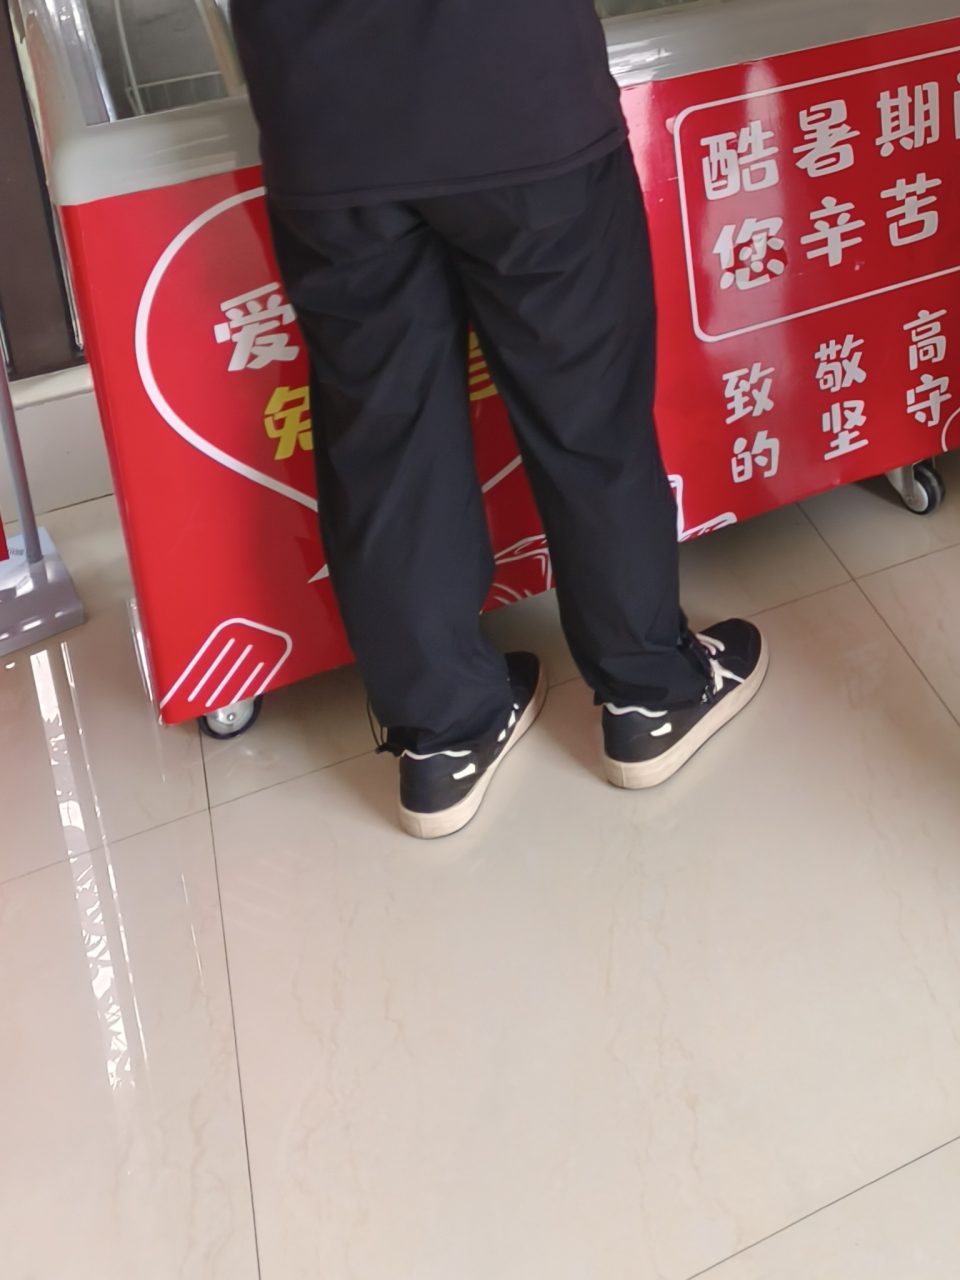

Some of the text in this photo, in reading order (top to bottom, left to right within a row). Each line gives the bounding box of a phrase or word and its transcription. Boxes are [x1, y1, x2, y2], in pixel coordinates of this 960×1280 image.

[213, 281, 300, 372] 爱
[730, 373, 952, 484] 的坚守
